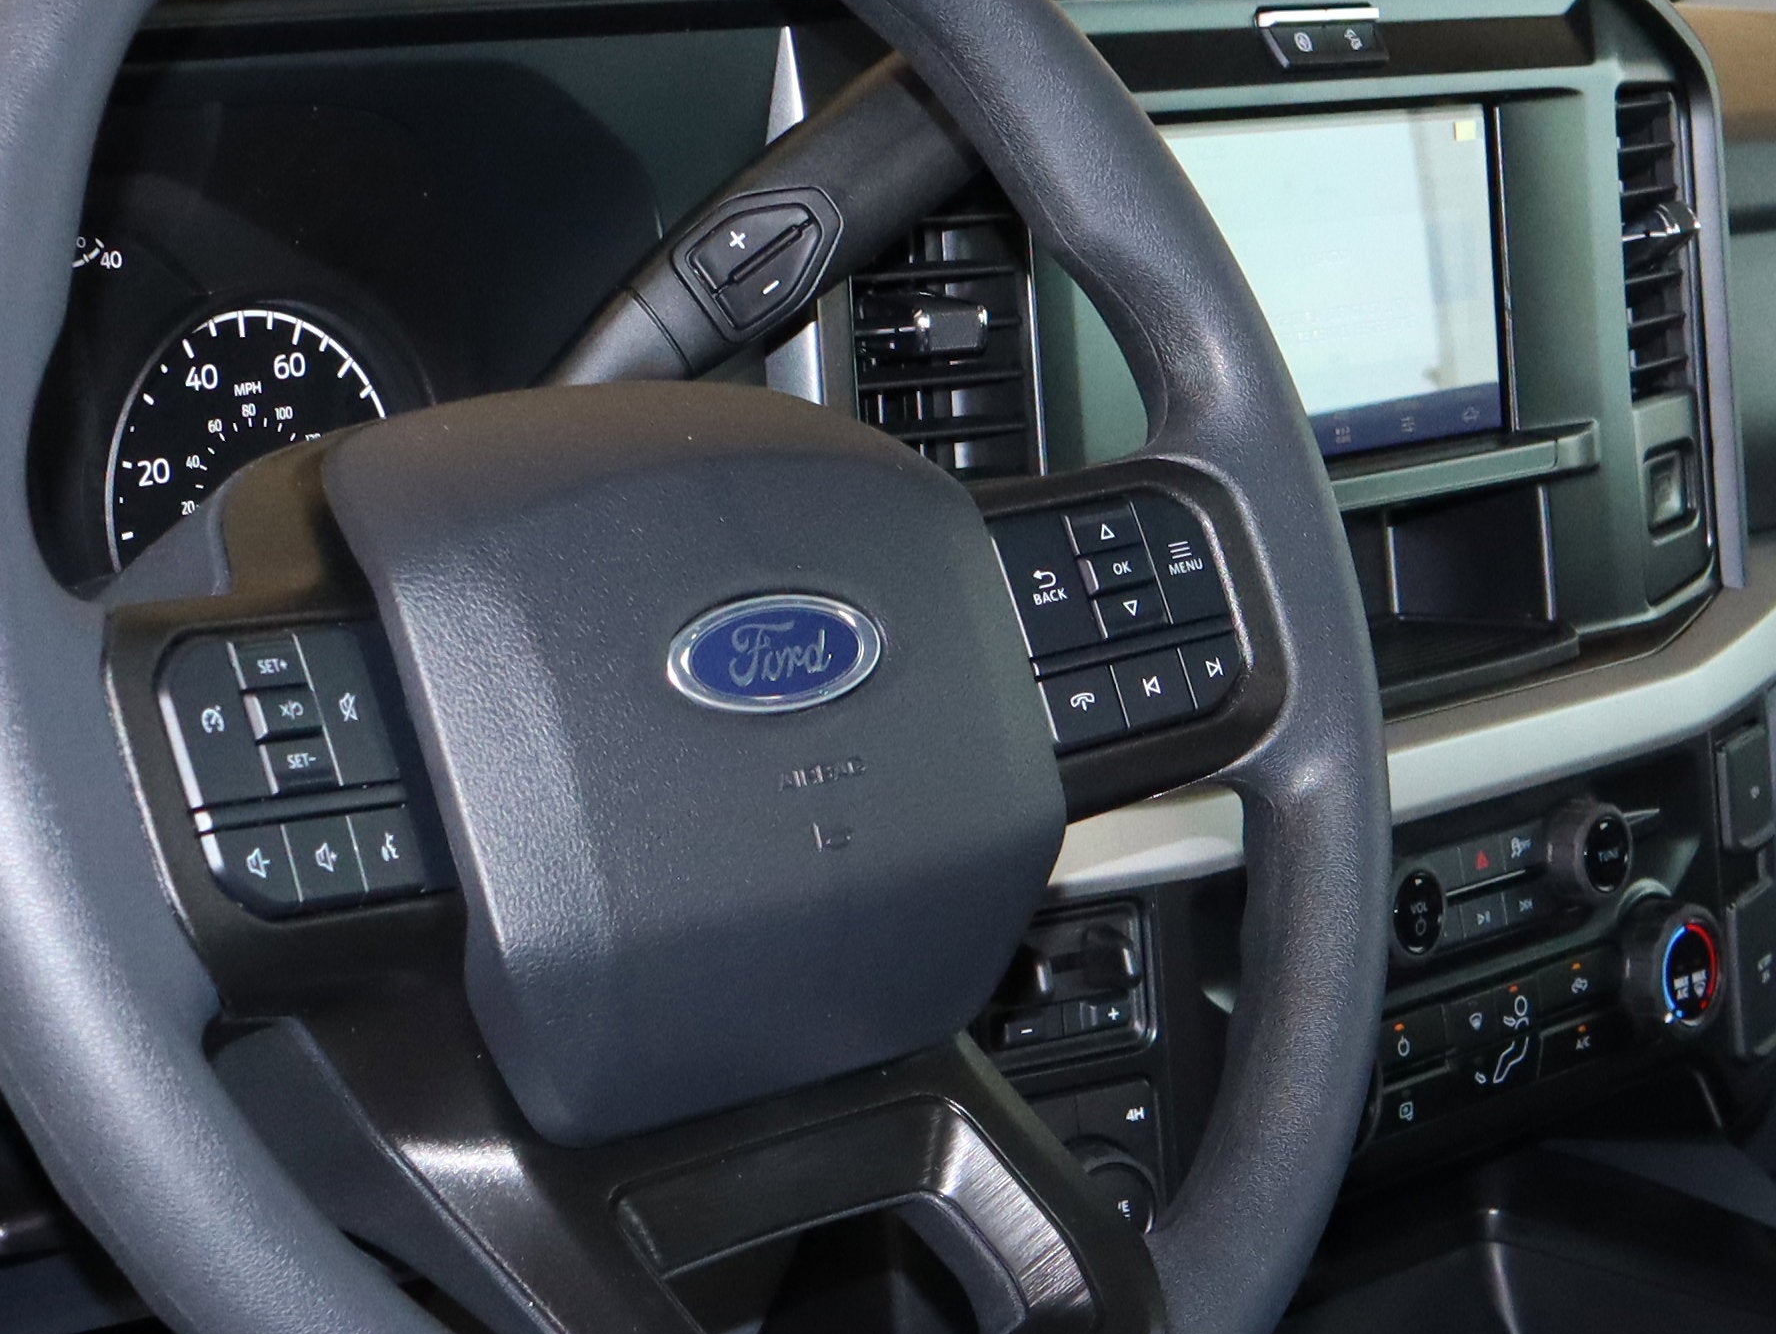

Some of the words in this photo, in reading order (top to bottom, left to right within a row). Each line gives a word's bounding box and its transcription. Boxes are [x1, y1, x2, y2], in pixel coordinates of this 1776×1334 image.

[100, 250, 123, 270] 40
[273, 352, 306, 380] 60
[185, 363, 218, 391] 40
[233, 380, 263, 397] MPH
[241, 403, 257, 418] 80
[274, 405, 293, 421] 100
[207, 418, 223, 434] 60
[185, 454, 201, 470] 40
[136, 457, 171, 487] 20
[180, 499, 196, 516] 20
[1112, 560, 1133, 576] OK
[1168, 557, 1204, 577] MENU
[1032, 587, 1068, 607] BACK
[728, 619, 833, 688] Ford
[1410, 901, 1428, 915] VOL
[1125, 1105, 1145, 1122] 4H
